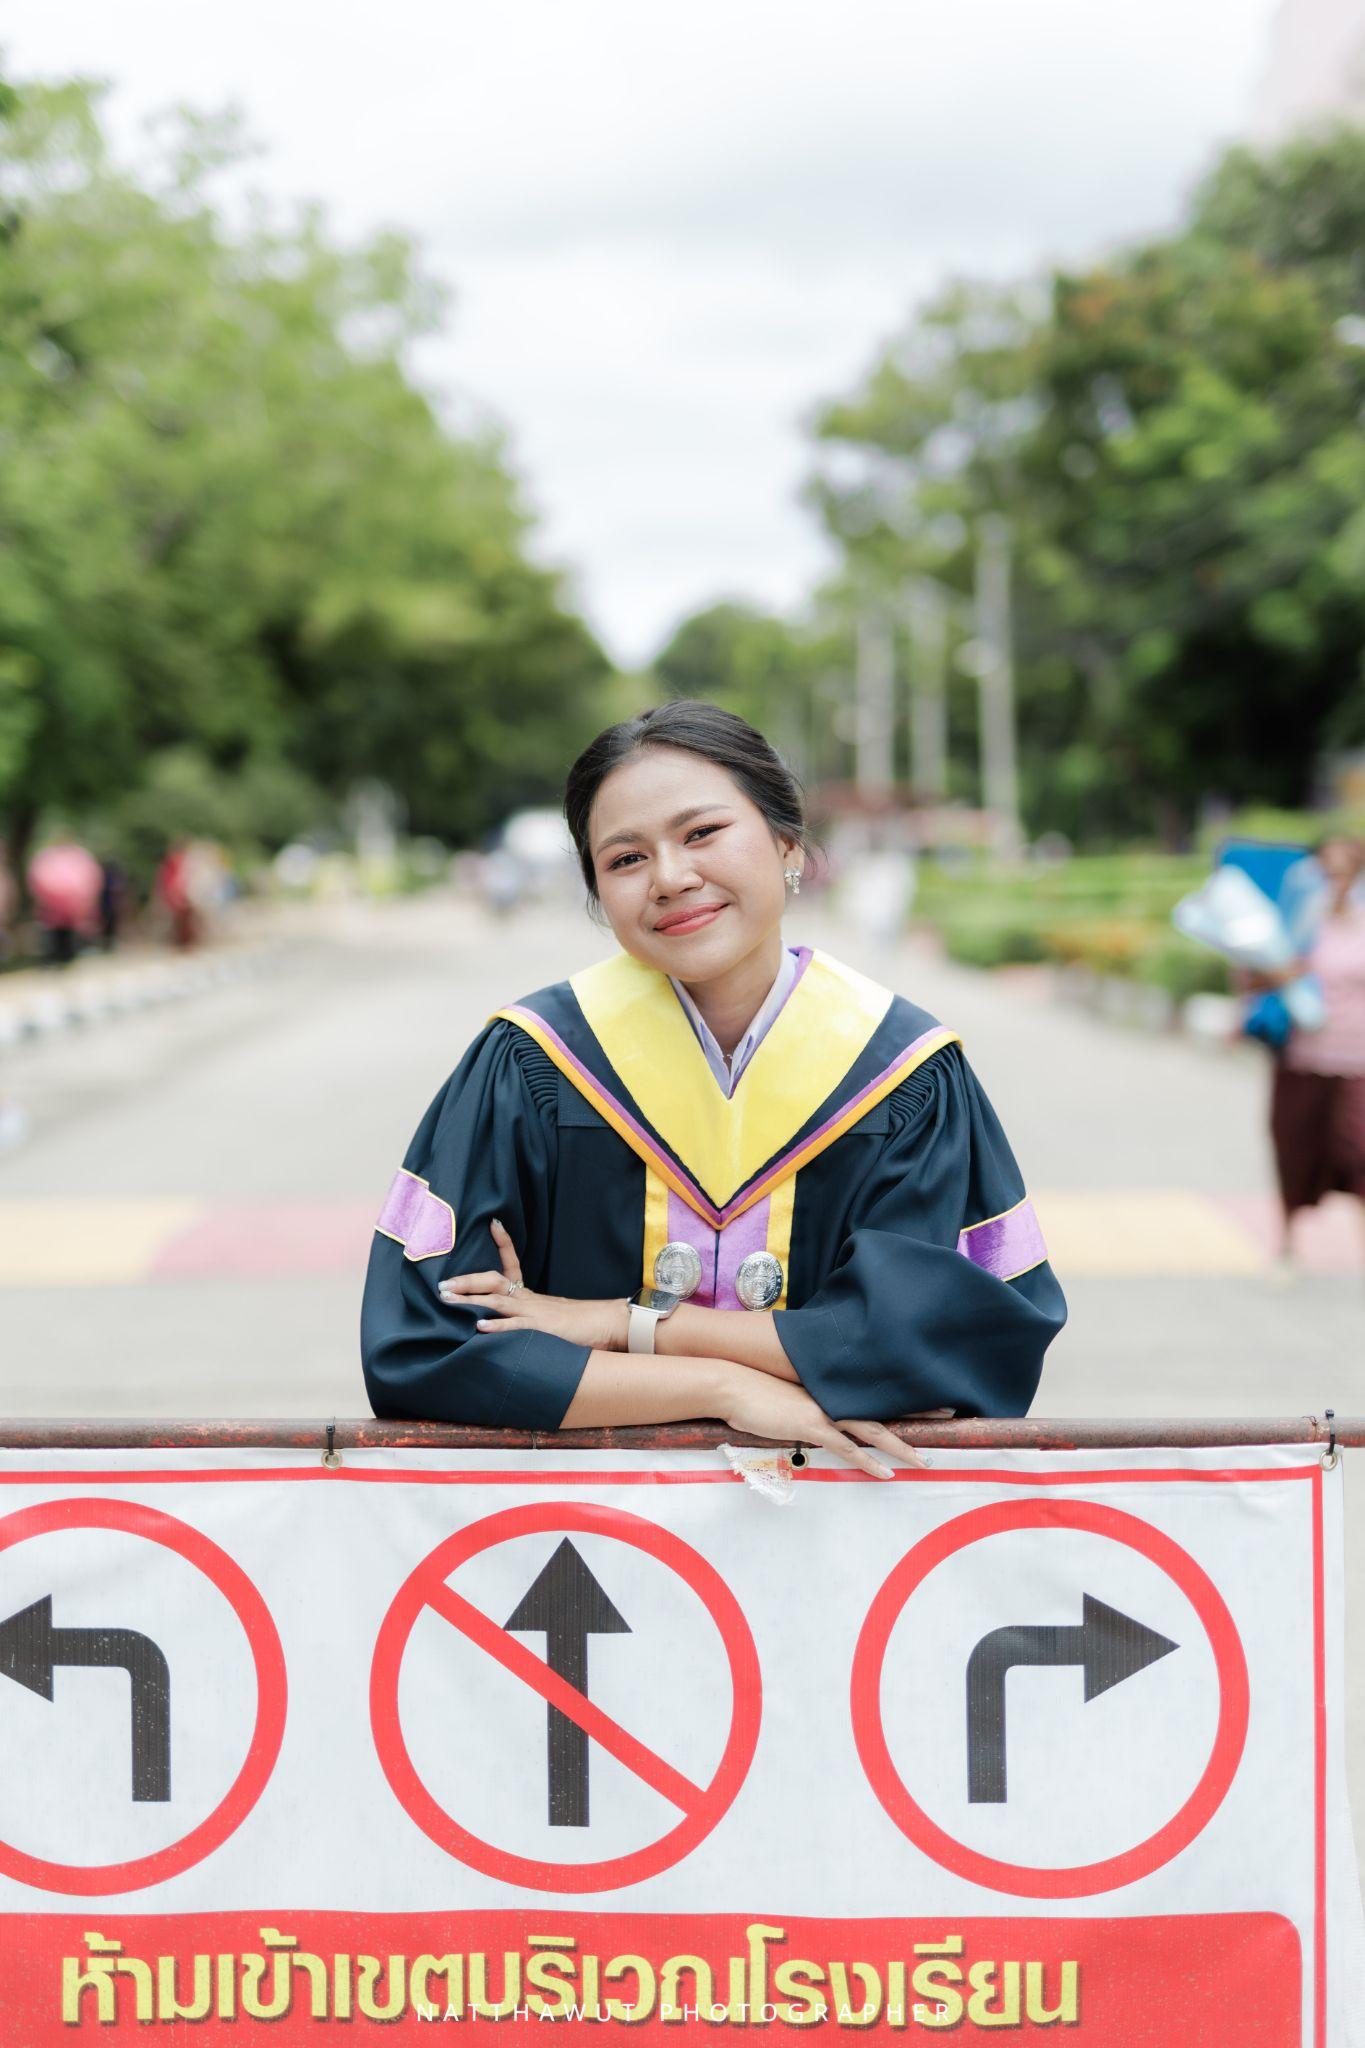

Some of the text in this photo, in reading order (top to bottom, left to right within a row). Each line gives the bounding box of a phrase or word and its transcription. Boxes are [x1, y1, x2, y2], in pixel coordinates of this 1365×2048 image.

[62, 1923, 1079, 2028] ห้ามเข้าเขตบริเวณโรงเรียน
